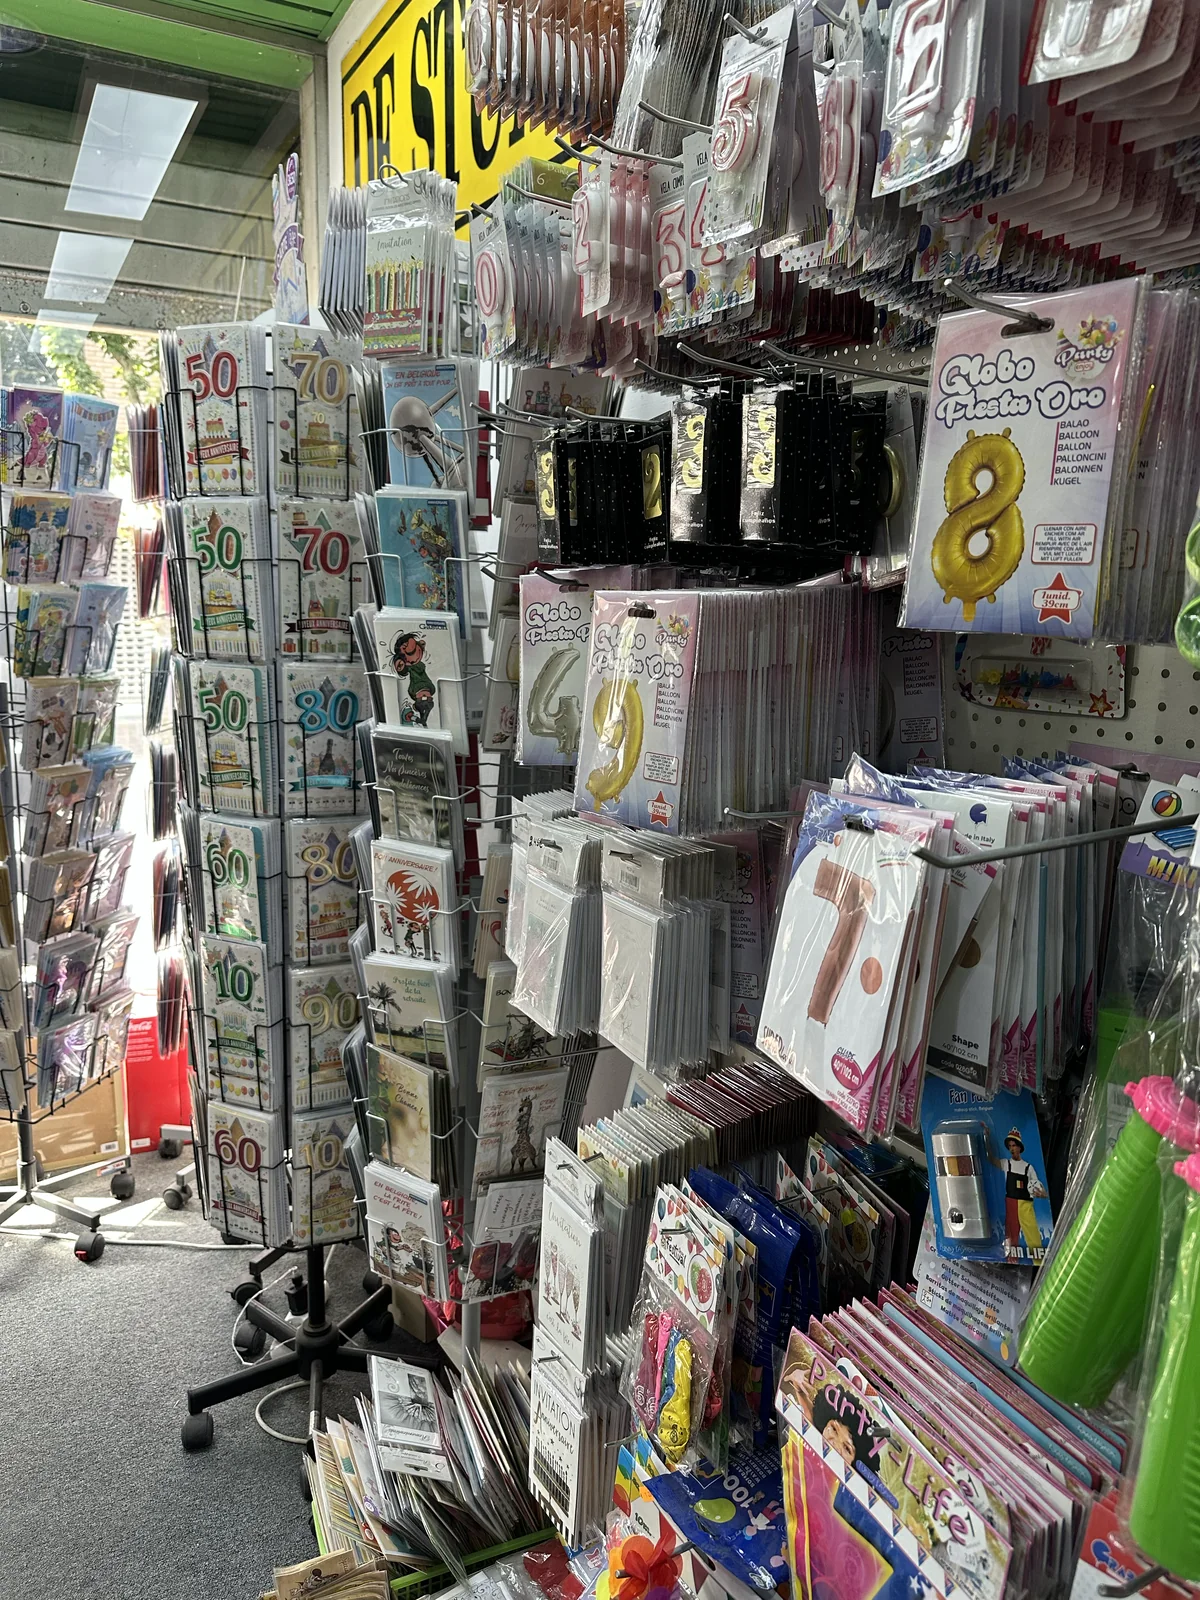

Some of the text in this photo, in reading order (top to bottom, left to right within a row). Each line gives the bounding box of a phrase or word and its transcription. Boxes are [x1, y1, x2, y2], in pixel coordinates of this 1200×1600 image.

[377, 236, 413, 250] Invitation
[1054, 344, 1115, 368] Party
[185, 350, 239, 400] 50
[290, 353, 347, 405] 70
[939, 349, 1035, 396] Globo
[935, 380, 1106, 429] Fiesta Oro
[1059, 430, 1100, 440] BALLOON
[1060, 419, 1090, 429] BALAO
[1056, 452, 1107, 463] PALLONCINI
[1058, 442, 1092, 452] BALLON
[1055, 464, 1103, 475] BALONNEN
[1053, 477, 1082, 486] KUGEL
[192, 526, 242, 571] 50
[294, 528, 350, 575] 70
[1042, 591, 1071, 600] 1unid.
[1042, 600, 1069, 608] 39cm
[314, 620, 349, 630] ANNIVERSAIRE
[525, 601, 581, 628] Globo
[525, 626, 575, 646] Fiesta
[656, 632, 688, 647] Party
[882, 634, 933, 657] Plata
[646, 654, 683, 680] Oro
[199, 689, 248, 732] 50
[296, 689, 359, 732] 80
[657, 698, 676, 706] BALLON
[980, 834, 995, 844] Italy
[207, 844, 249, 888] 60
[302, 842, 358, 885] 80
[731, 929, 757, 937] ALLONCINI
[731, 936, 756, 944] ALONNEN
[212, 961, 254, 1002] 10
[393, 976, 414, 988] Profite
[303, 992, 359, 1031] 90
[952, 1034, 979, 1050] Shape
[967, 1052, 979, 1060] cm
[949, 1088, 968, 1104] Fan
[215, 1130, 261, 1172] 60
[373, 1195, 390, 1206] C'EST
[393, 1195, 411, 1207] FRITE
[941, 1263, 1004, 1306] Glitter Schminkstiften
[941, 1274, 1000, 1314] Glitter Schminkstifte
[926, 1274, 1014, 1334] Barritas de maquillaje brillantes
[928, 1286, 945, 1300] Sticks
[945, 1298, 952, 1306] de
[989, 1325, 1007, 1341] brilho
[940, 1305, 988, 1340] Matite luccicanti
[534, 1382, 577, 1440] INVITATION
[533, 1399, 574, 1456] Anniversaire
